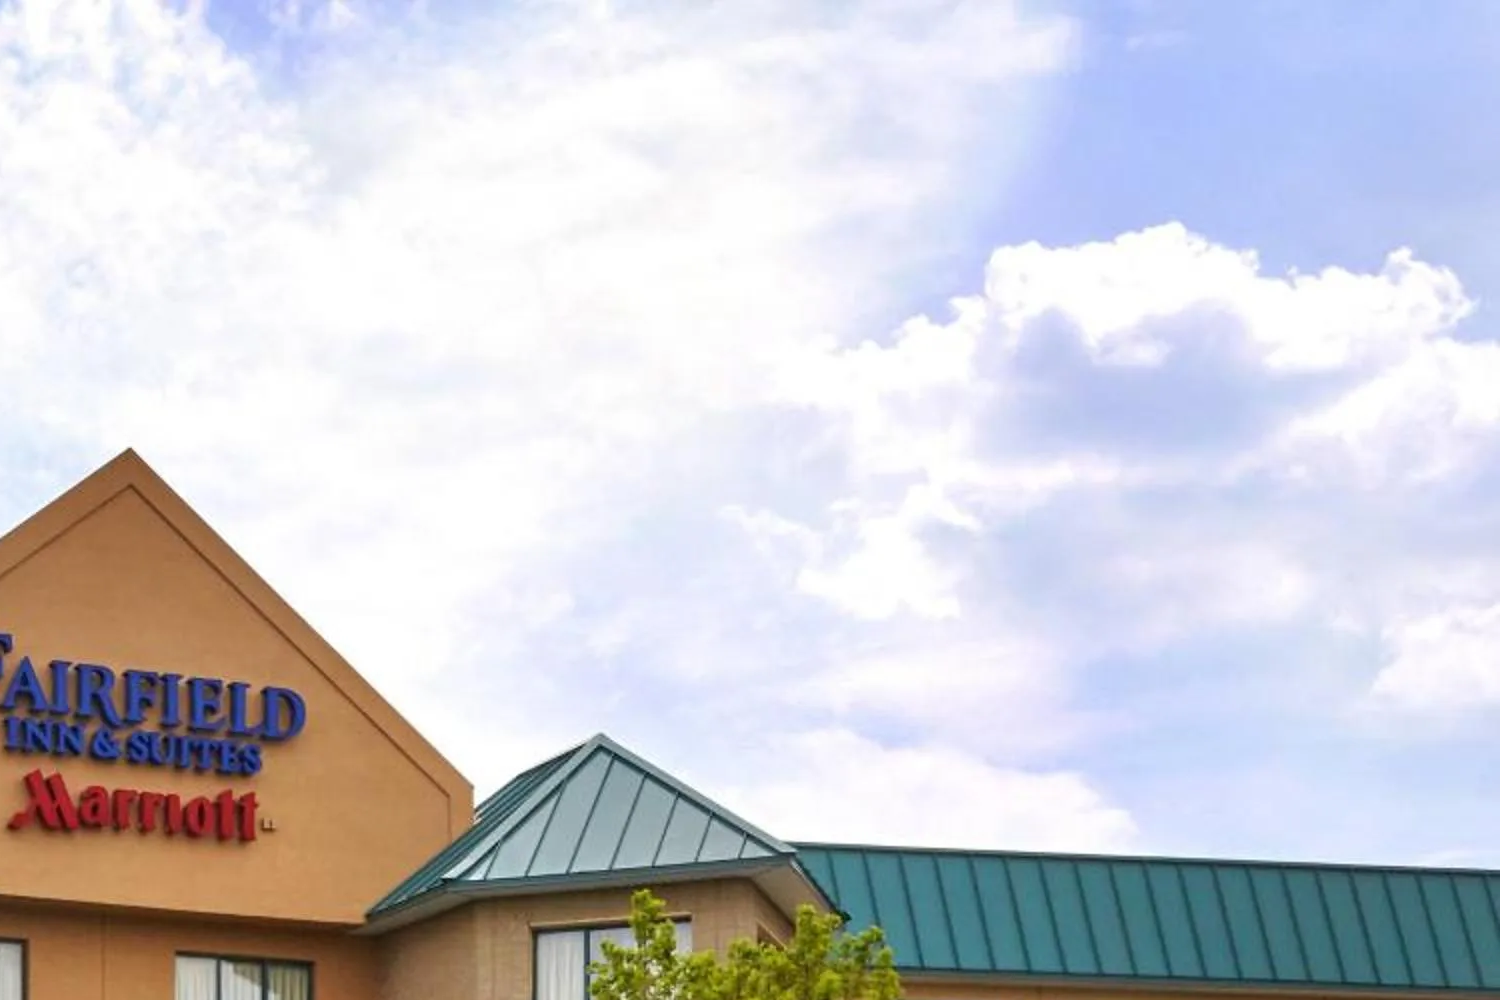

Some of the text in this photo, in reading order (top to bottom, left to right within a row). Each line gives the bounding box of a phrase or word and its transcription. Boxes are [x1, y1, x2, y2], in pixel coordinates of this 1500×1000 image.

[3, 715, 264, 777] INN & SUITES
[6, 768, 260, 842] Marriott
